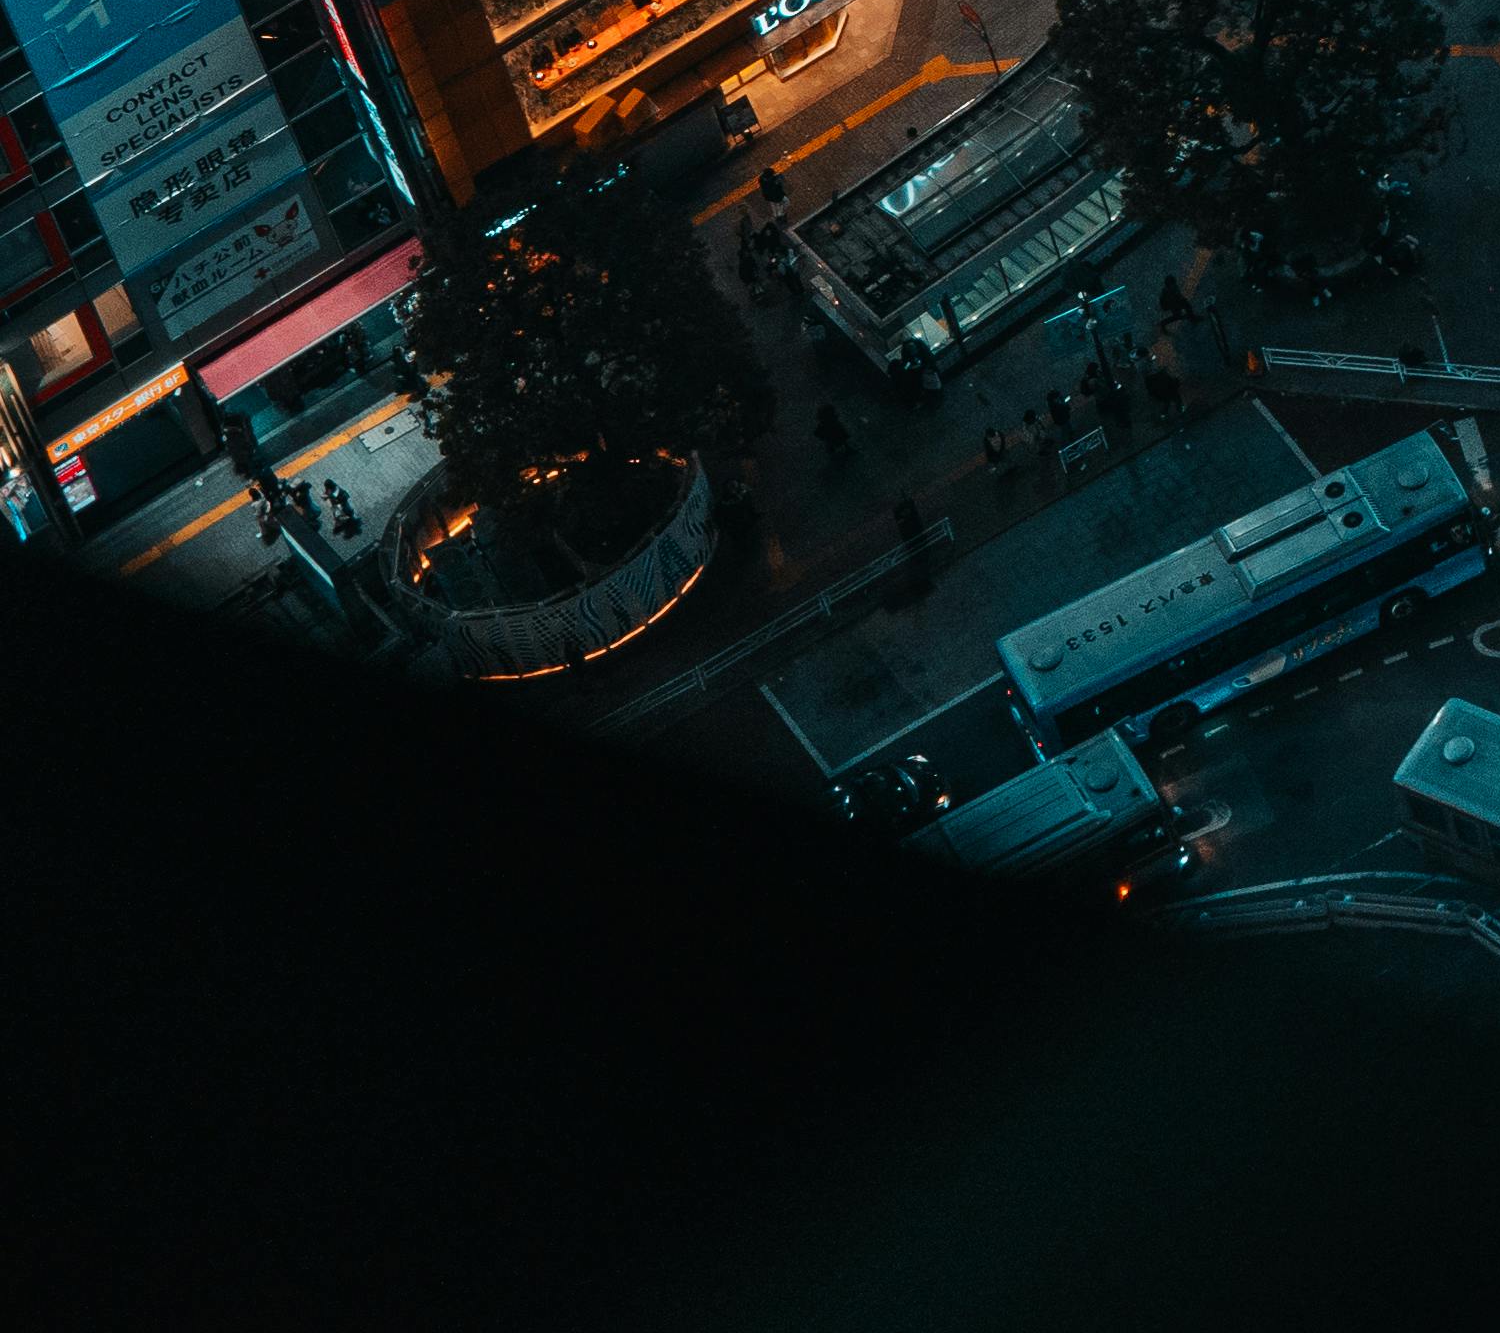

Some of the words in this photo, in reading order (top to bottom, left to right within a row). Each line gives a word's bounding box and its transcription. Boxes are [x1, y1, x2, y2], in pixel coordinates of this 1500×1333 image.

[106, 51, 211, 125] CONTACT
[135, 83, 196, 129] LENS
[100, 72, 245, 168] SPECIALISTS
[170, 244, 267, 309] 献血ルーム
[173, 232, 253, 289] ハチ公前
[72, 383, 164, 445] 東京スター銀行
